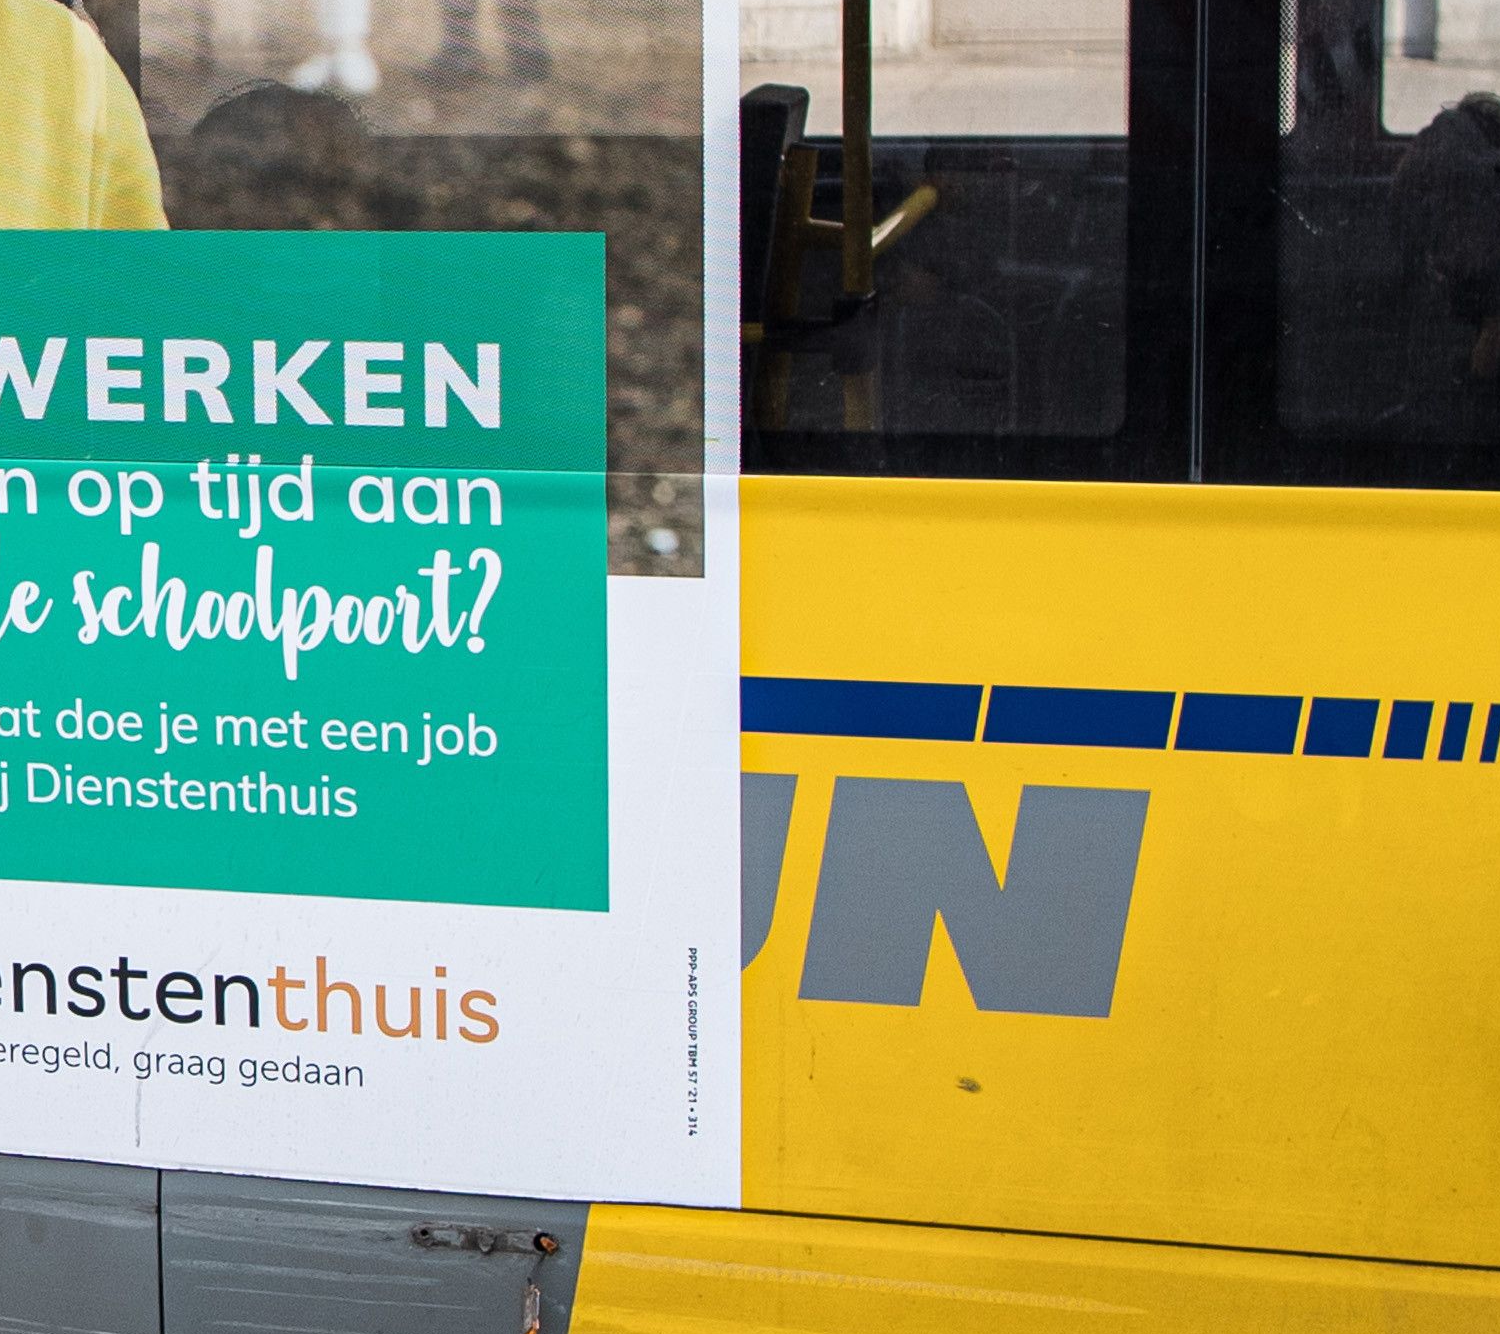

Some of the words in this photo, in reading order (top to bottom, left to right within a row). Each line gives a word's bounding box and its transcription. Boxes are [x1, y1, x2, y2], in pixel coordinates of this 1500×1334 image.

[68, 470, 163, 535] op
[190, 454, 313, 538] tijd
[349, 476, 502, 525] aan
[73, 542, 502, 680] schoolpoort?
[56, 698, 142, 741] doe
[155, 702, 197, 754] je
[216, 711, 308, 749] met
[322, 720, 408, 752] een
[417, 713, 497, 765] job
[27, 763, 357, 817] Dienstenthuis
[688, 948, 697, 997] PPP-APS
[688, 1000, 697, 1040] GROUP
[134, 1052, 225, 1084] graag
[239, 1056, 363, 1087] gedaan
[688, 1044, 697, 1067] TBM
[688, 1117, 697, 1136] 314
